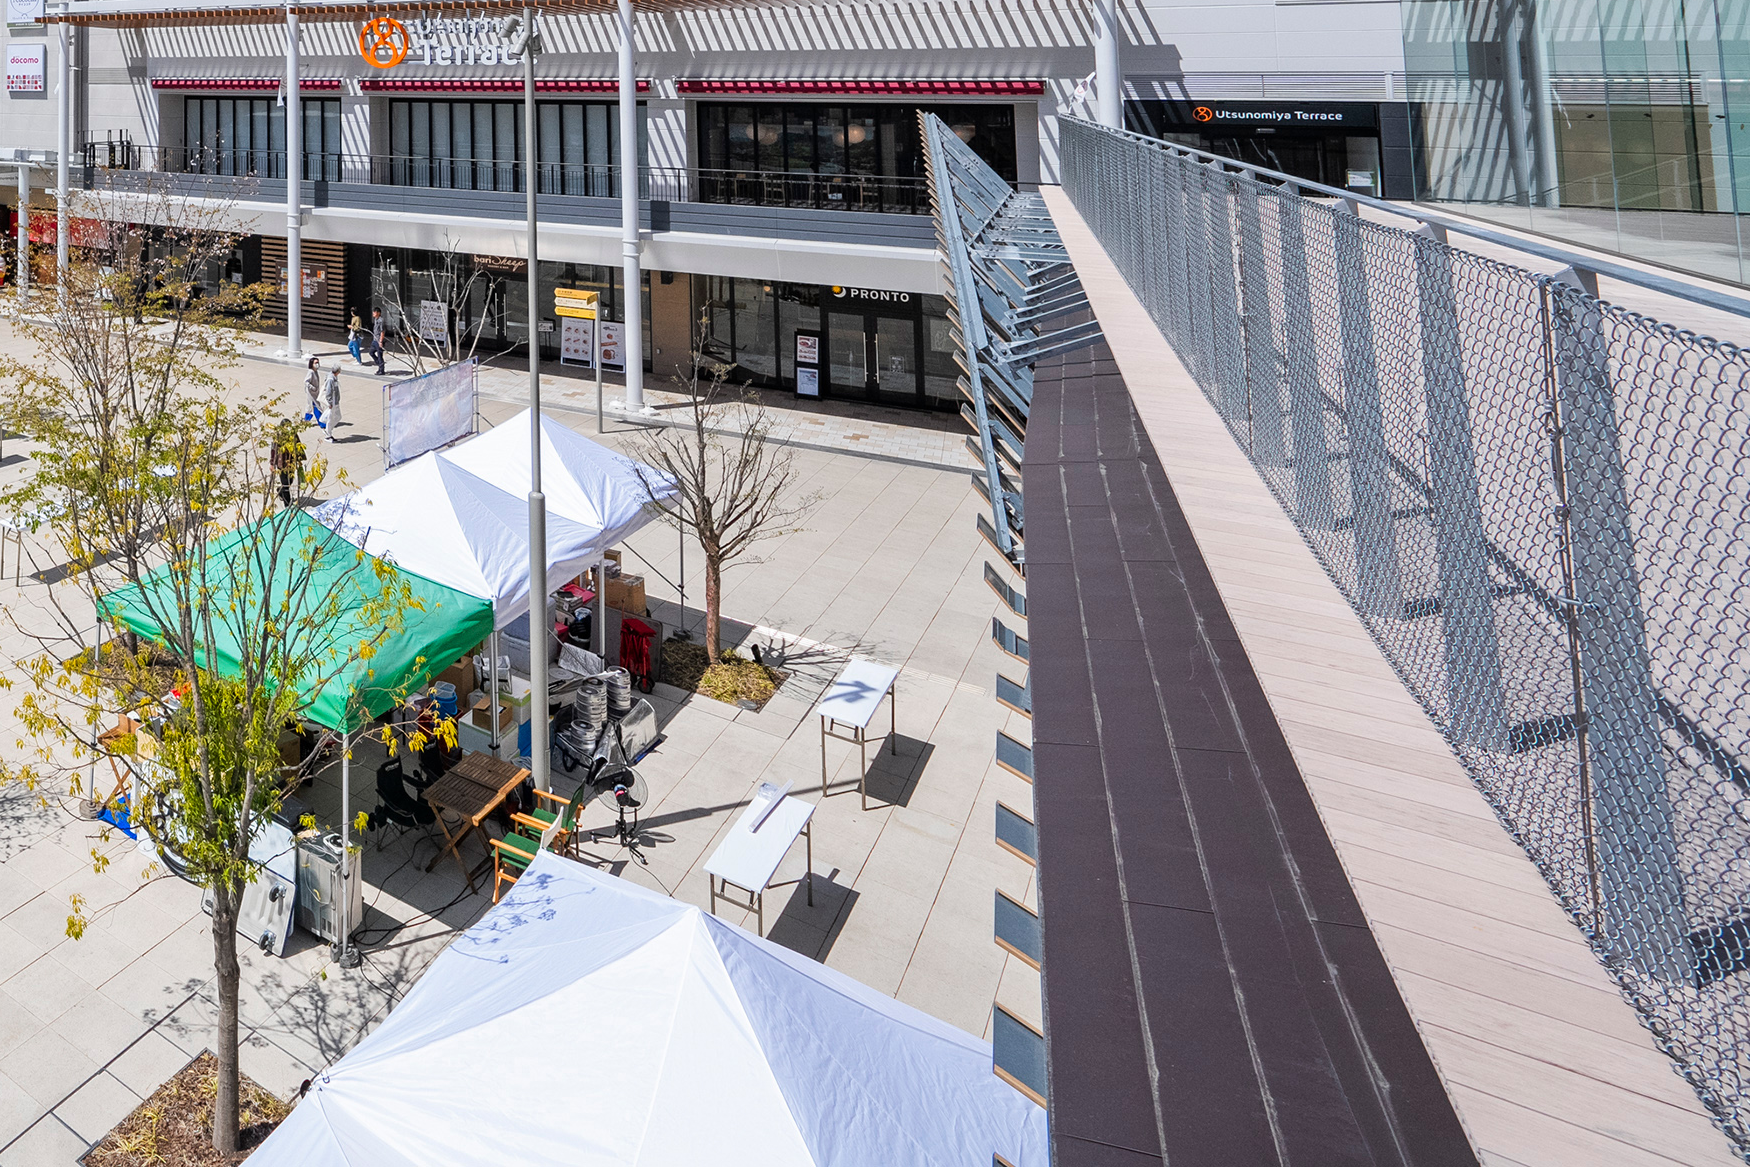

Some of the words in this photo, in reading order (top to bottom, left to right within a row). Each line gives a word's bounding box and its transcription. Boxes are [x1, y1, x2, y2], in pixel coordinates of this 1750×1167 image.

[10, 56, 39, 64] docomo
[1215, 110, 1292, 122] Utsunomiya
[1294, 110, 1343, 121] Terrace
[850, 288, 910, 303] PRONTO
